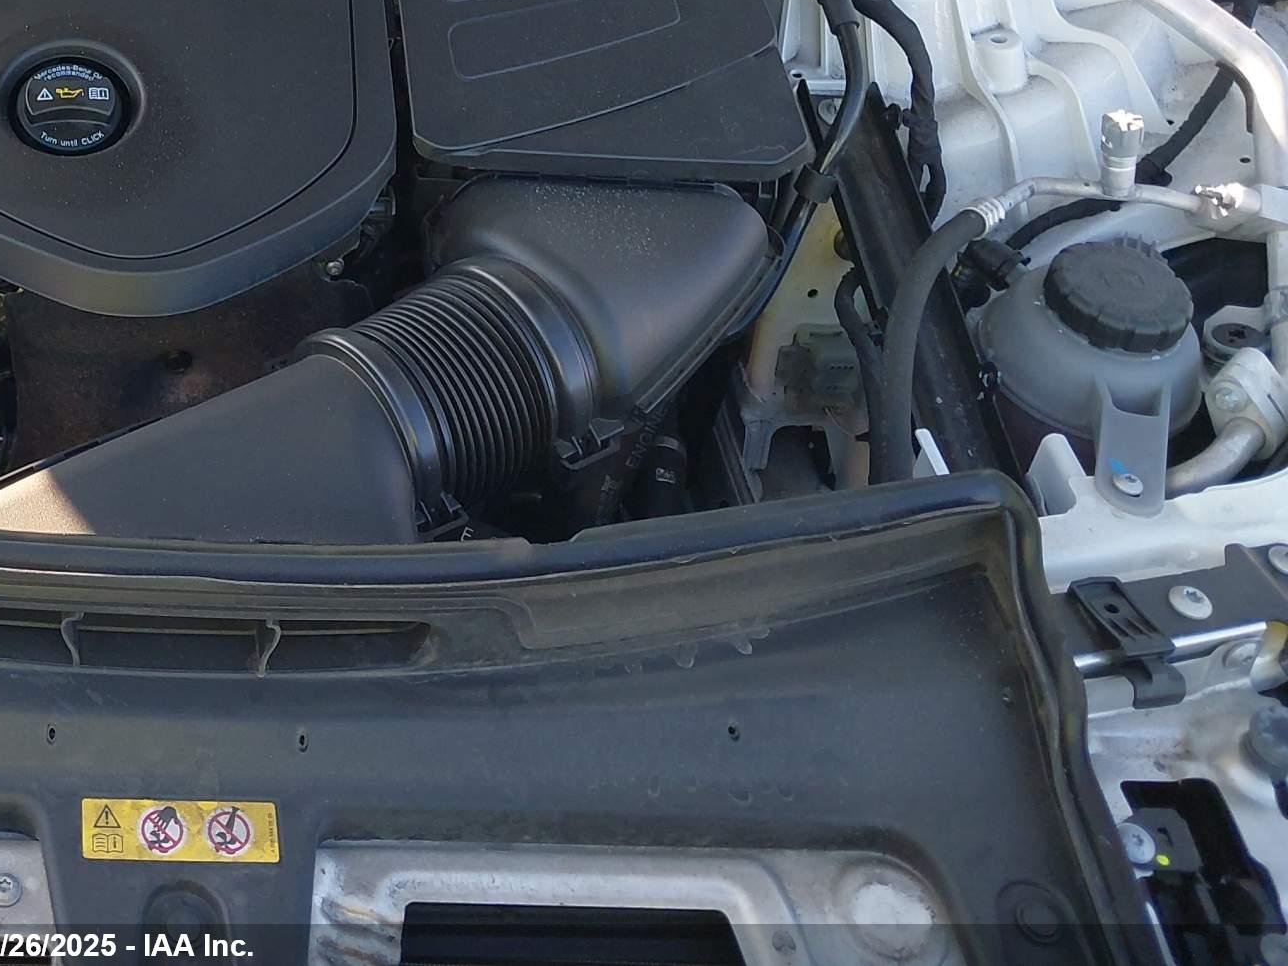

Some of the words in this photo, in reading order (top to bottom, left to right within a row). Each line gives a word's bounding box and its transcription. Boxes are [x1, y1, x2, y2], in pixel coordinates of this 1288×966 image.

[43, 70, 95, 82] recommended
[40, 131, 58, 146] Turn
[60, 138, 78, 148] until
[81, 131, 105, 146] CLICK
